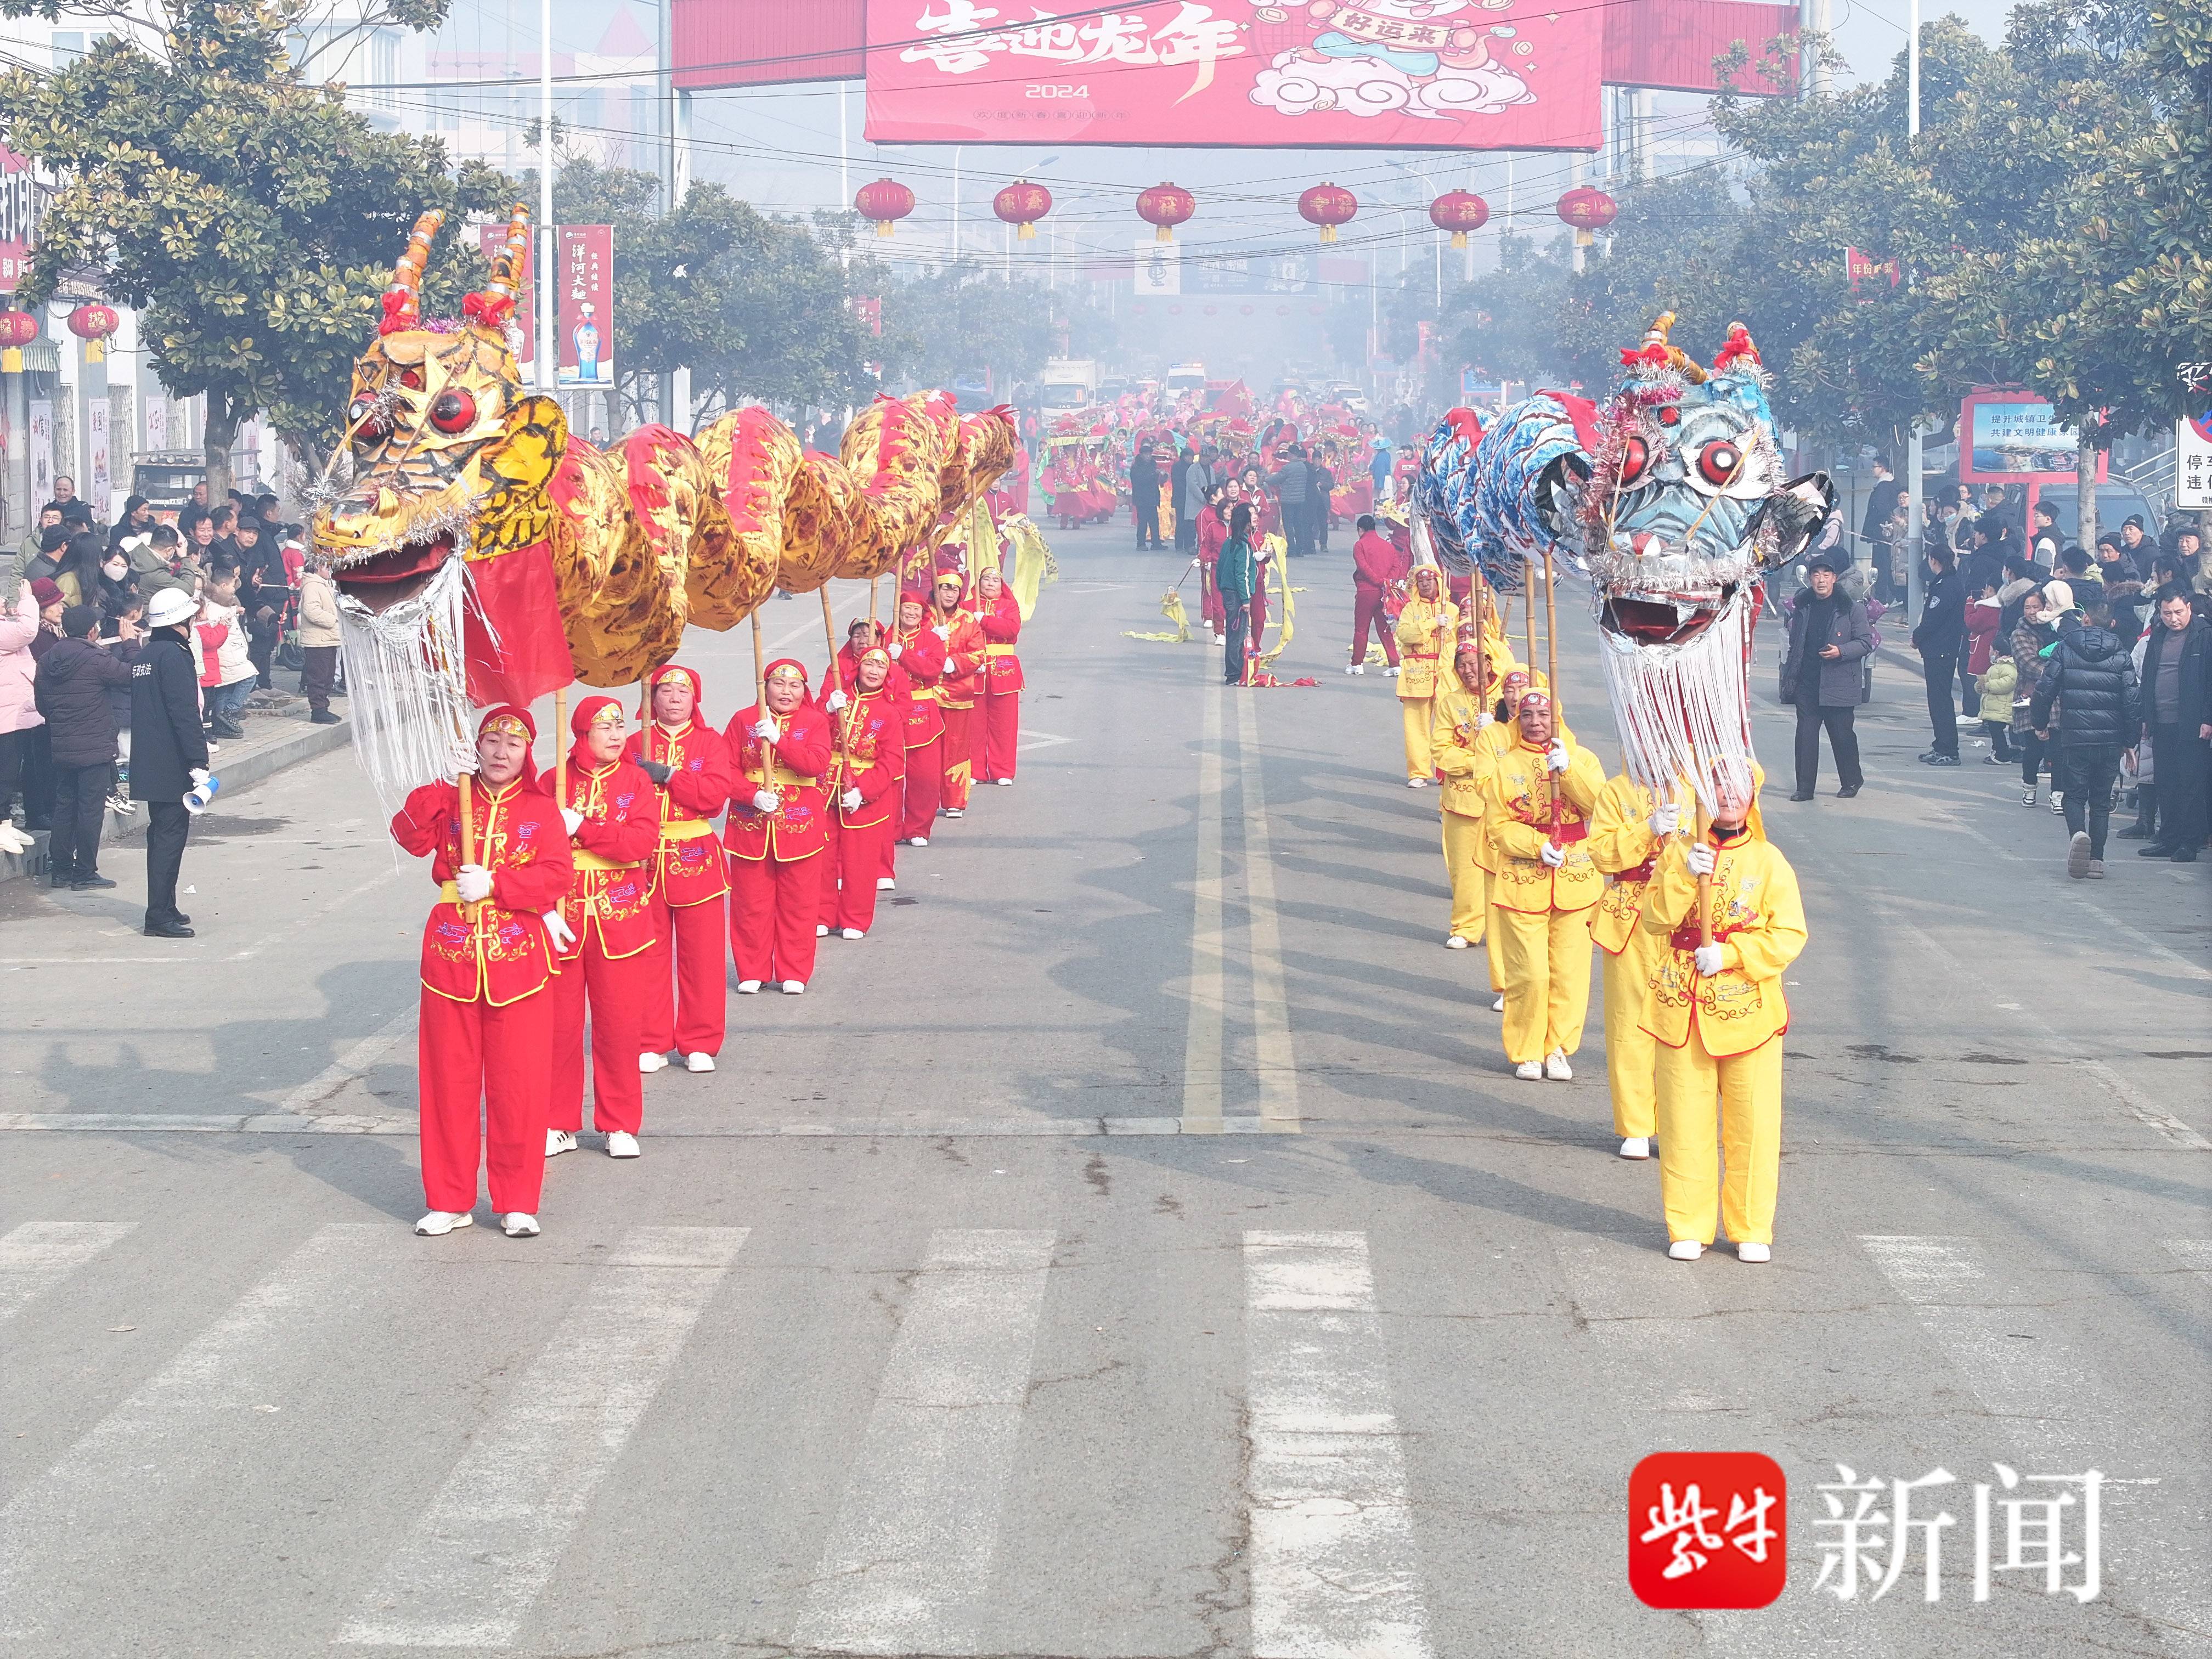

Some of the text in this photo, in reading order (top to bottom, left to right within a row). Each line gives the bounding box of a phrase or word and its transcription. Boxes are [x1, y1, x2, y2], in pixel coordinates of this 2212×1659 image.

[1342, 13, 1437, 44] 好运来
[900, 0, 1246, 108] 喜迎龙年
[1025, 84, 1090, 99] 2024
